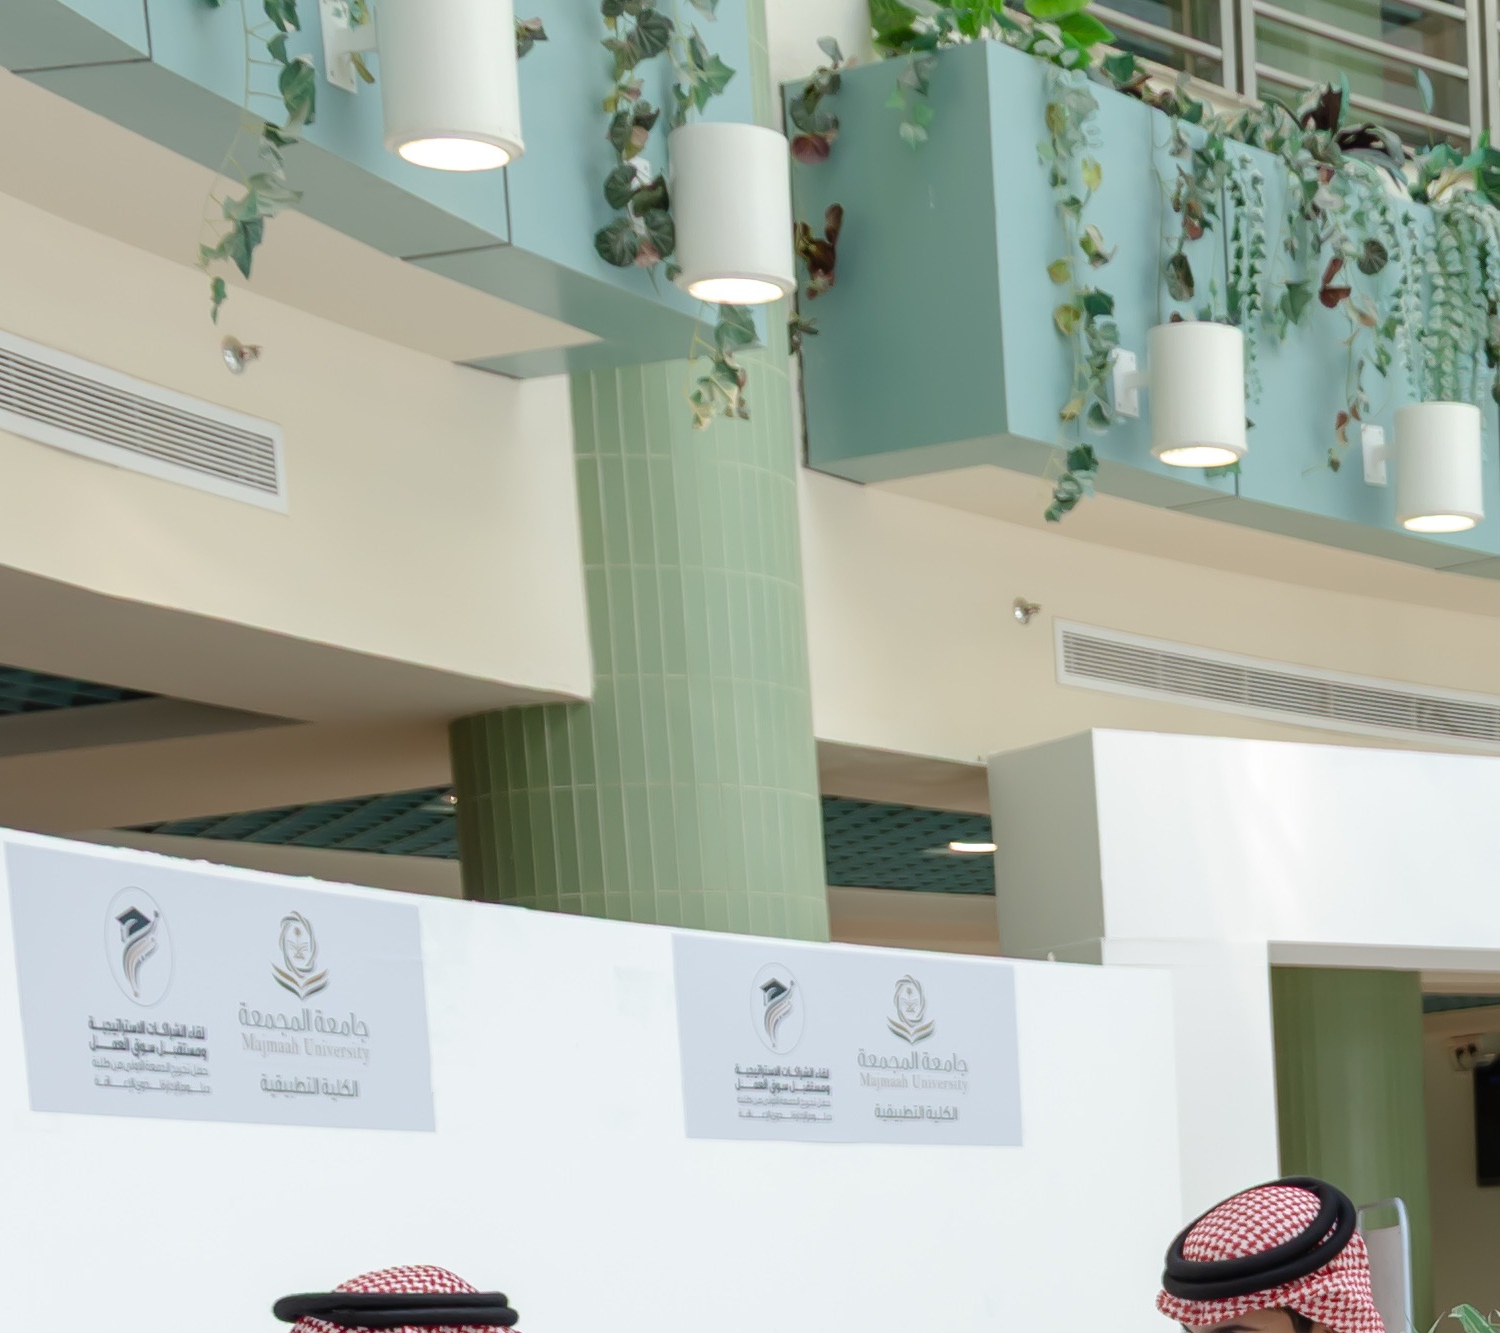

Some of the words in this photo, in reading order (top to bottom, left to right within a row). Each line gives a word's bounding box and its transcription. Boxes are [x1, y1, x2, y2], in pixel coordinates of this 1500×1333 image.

[238, 1001, 311, 1037] المجمعة
[315, 1008, 369, 1043] جامعة
[241, 1032, 300, 1058] Majmaah
[303, 1037, 369, 1066] University
[857, 1048, 919, 1074] المجمعة
[921, 1051, 969, 1077] جامعة
[260, 1073, 320, 1099] التطبيقية
[322, 1077, 359, 1102] الكلية
[859, 1072, 908, 1091] Majmaah
[912, 1074, 968, 1096] University
[874, 1103, 925, 1122] التطبيقية
[926, 1105, 959, 1123] الكلية
